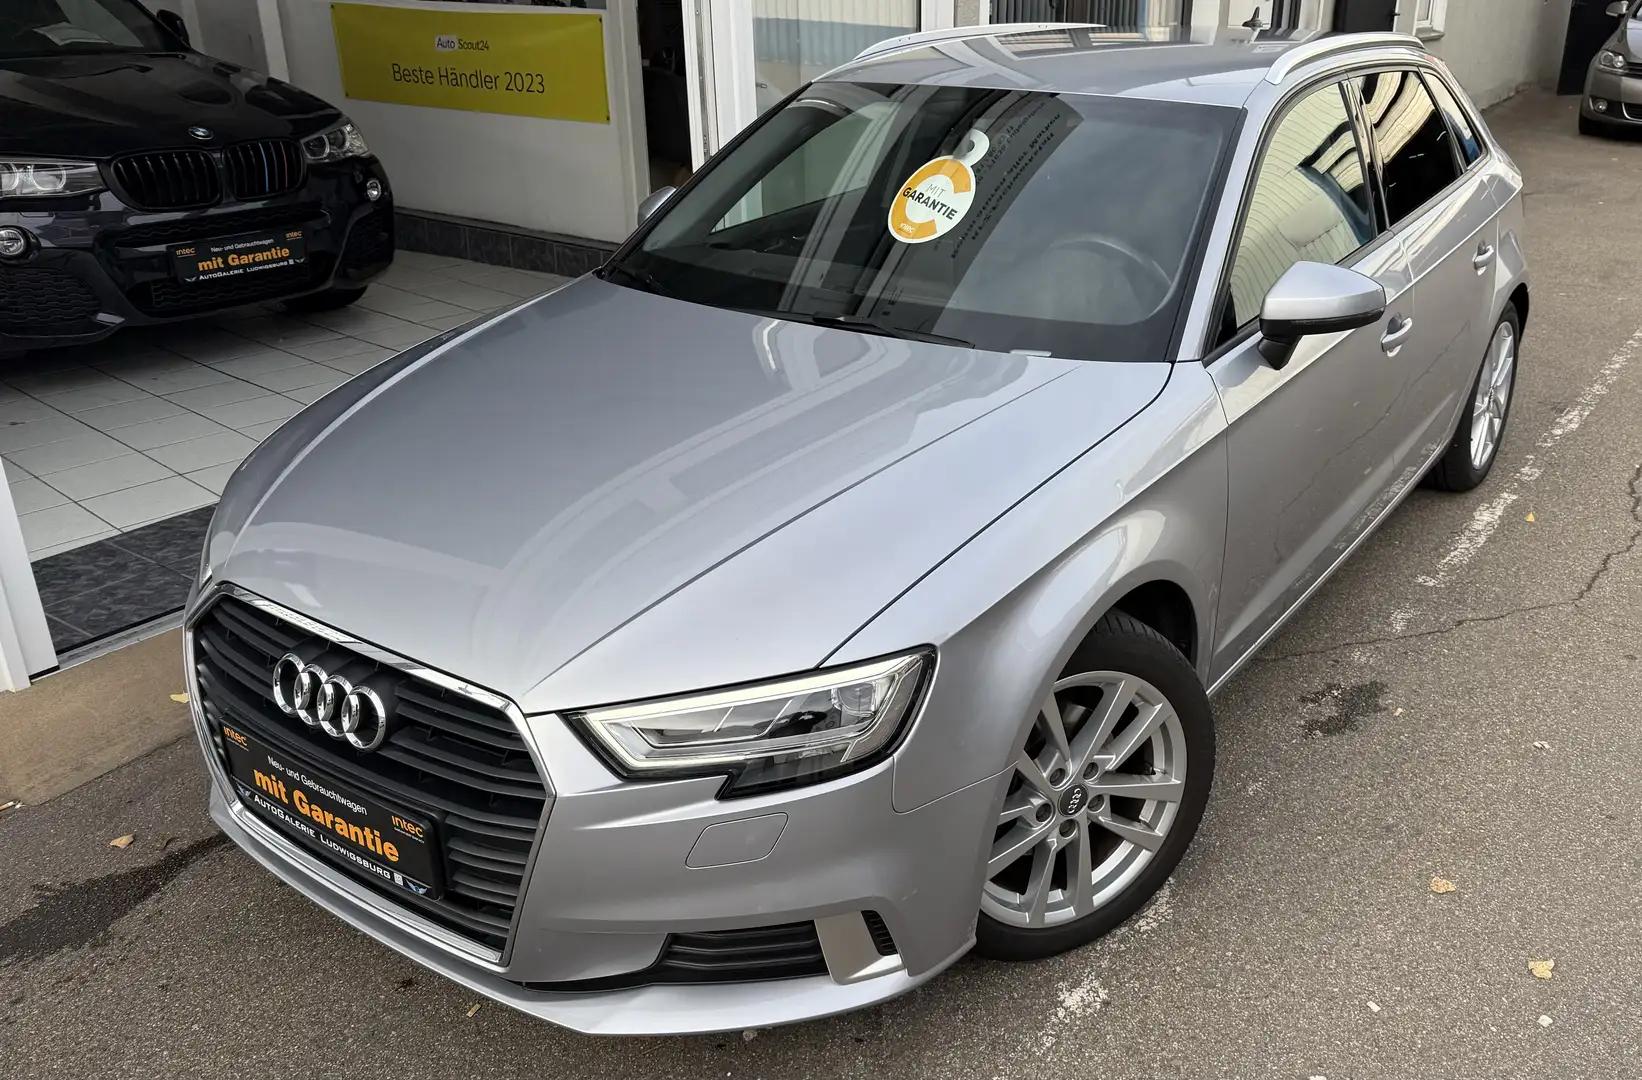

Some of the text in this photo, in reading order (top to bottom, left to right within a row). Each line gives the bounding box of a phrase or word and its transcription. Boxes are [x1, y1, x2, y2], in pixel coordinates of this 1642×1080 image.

[436, 37, 489, 51] Auto Scout24
[391, 62, 545, 94] Beste Händler 2023
[925, 184, 946, 198] MIT
[902, 187, 958, 220] GARANTIE
[235, 238, 274, 249] Gebrauchtwagen
[198, 247, 290, 271] mit Garantie
[224, 726, 248, 746] intec
[267, 755, 368, 816] Neu- und Gebrauchtwagen
[253, 768, 400, 862] mit Garantie
[391, 815, 424, 838] intec
